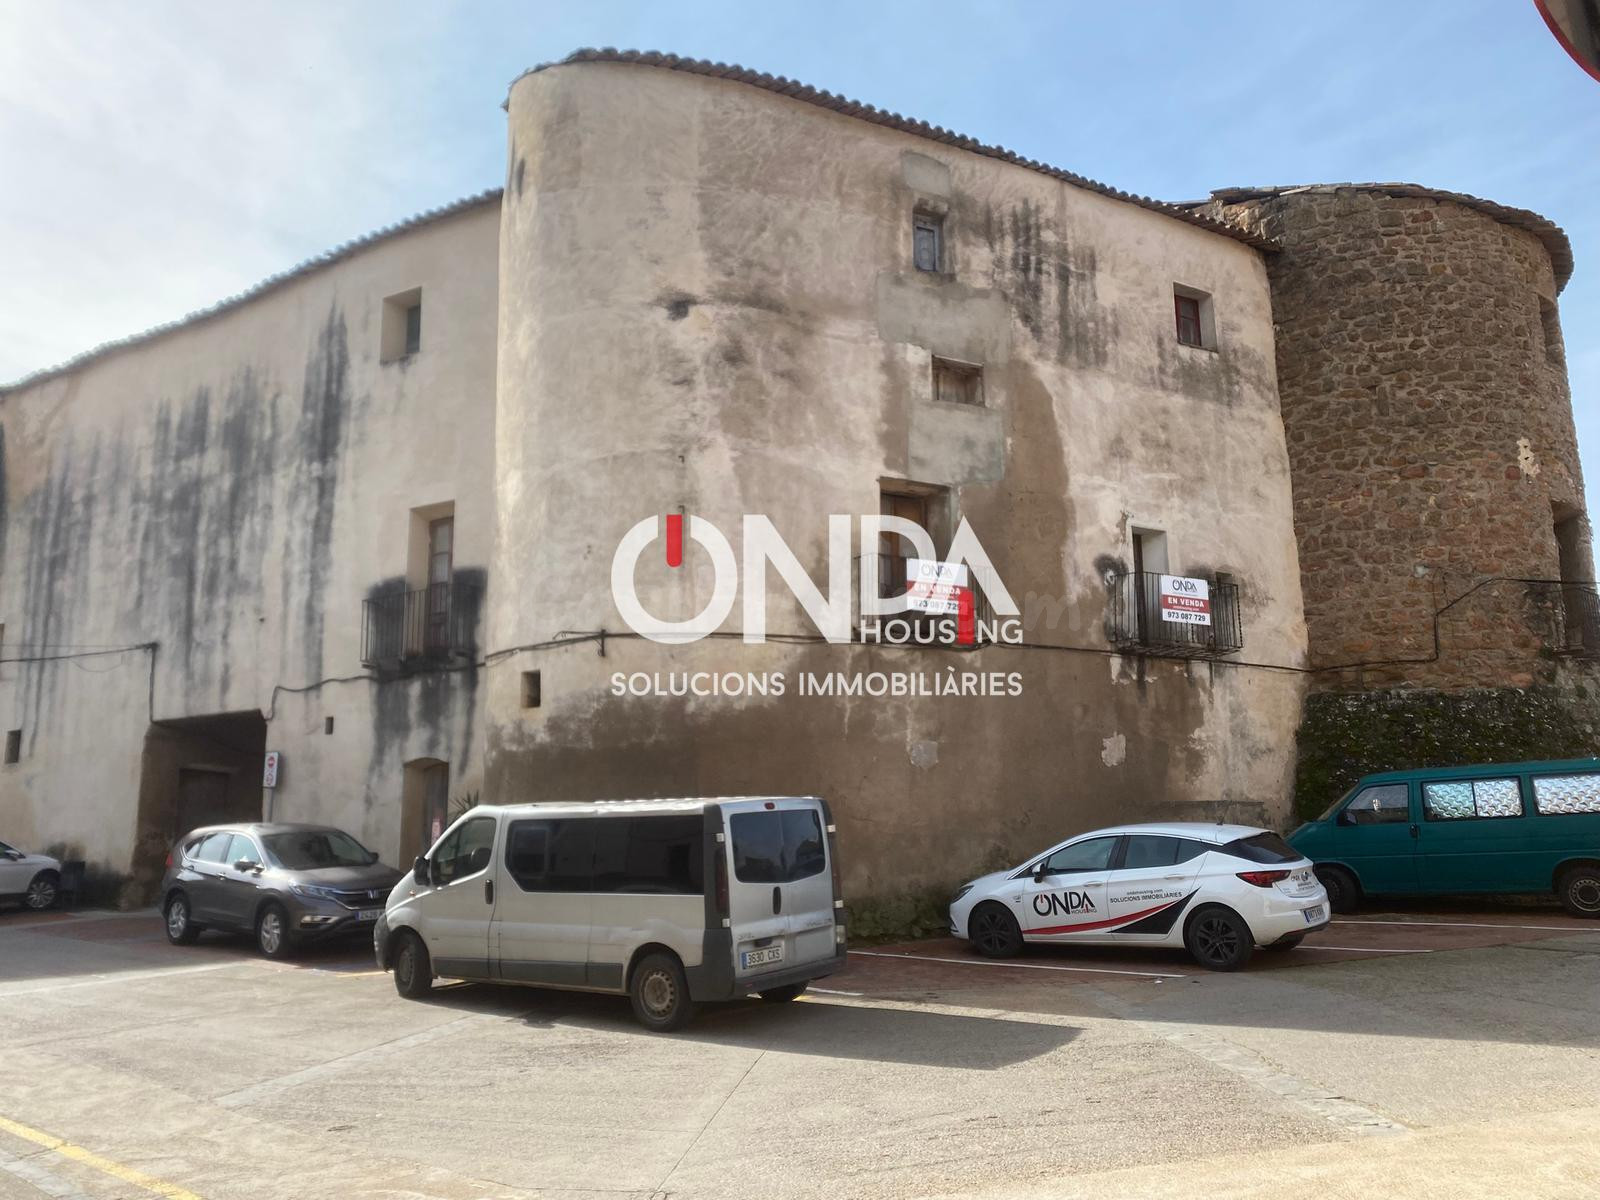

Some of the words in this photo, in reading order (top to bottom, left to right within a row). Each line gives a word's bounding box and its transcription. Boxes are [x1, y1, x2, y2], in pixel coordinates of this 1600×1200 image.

[1172, 579, 1198, 592] ONDA
[1180, 598, 1204, 607] VENDA
[1168, 611, 1179, 619] 973
[1033, 891, 1096, 916] ONDA
[747, 951, 765, 965] 3630
